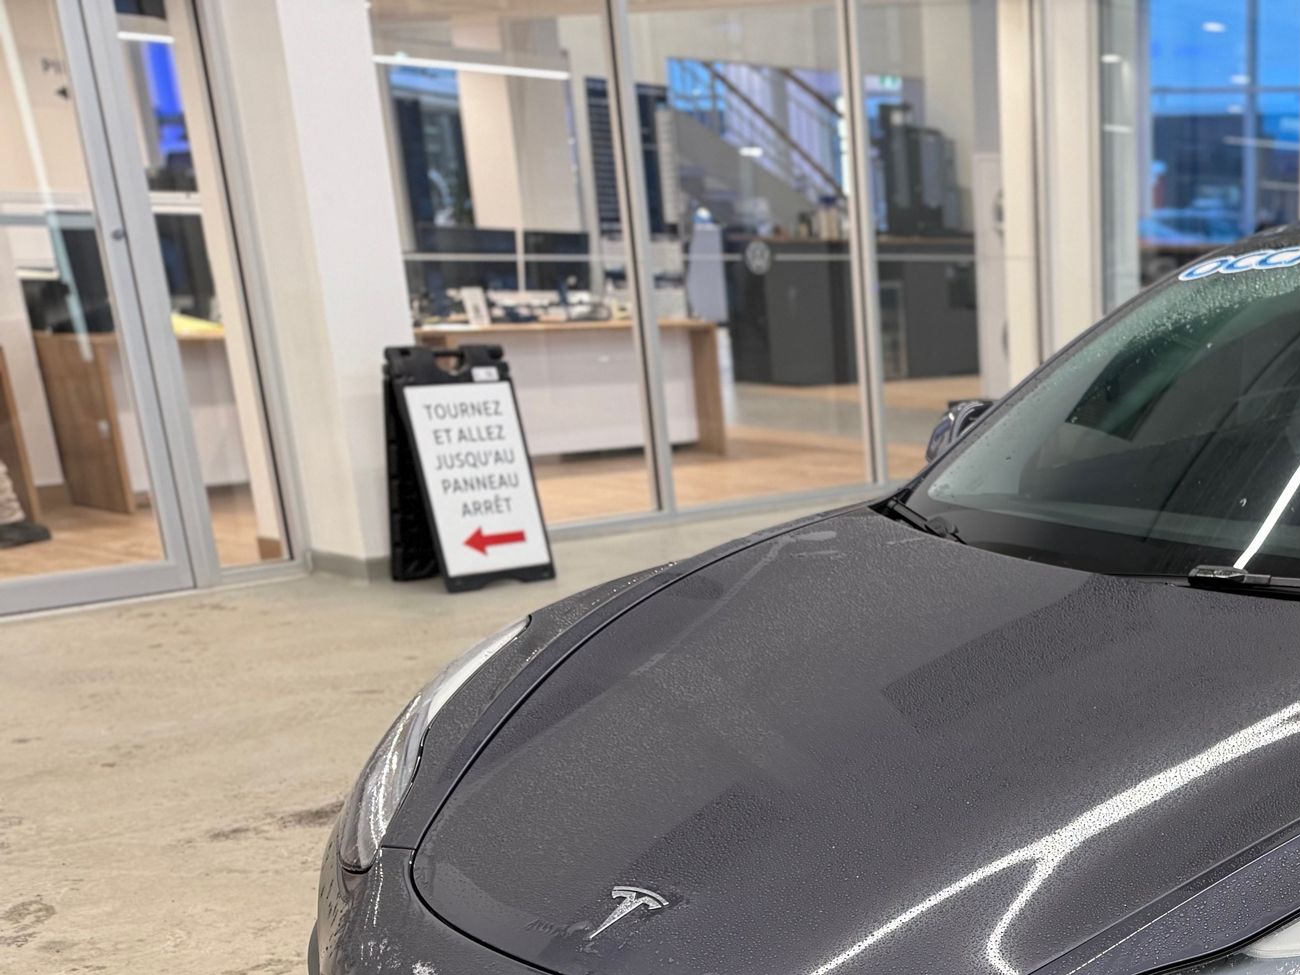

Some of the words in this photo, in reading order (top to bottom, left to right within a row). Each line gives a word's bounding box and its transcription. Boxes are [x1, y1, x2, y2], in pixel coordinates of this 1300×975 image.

[423, 400, 502, 420] TOURNEZ
[433, 428, 452, 445] ET
[457, 425, 505, 442] ALLEZ
[435, 449, 515, 470] JUSQU'AU
[441, 473, 520, 494] PANNEAU
[461, 495, 512, 518] ARRÊT
